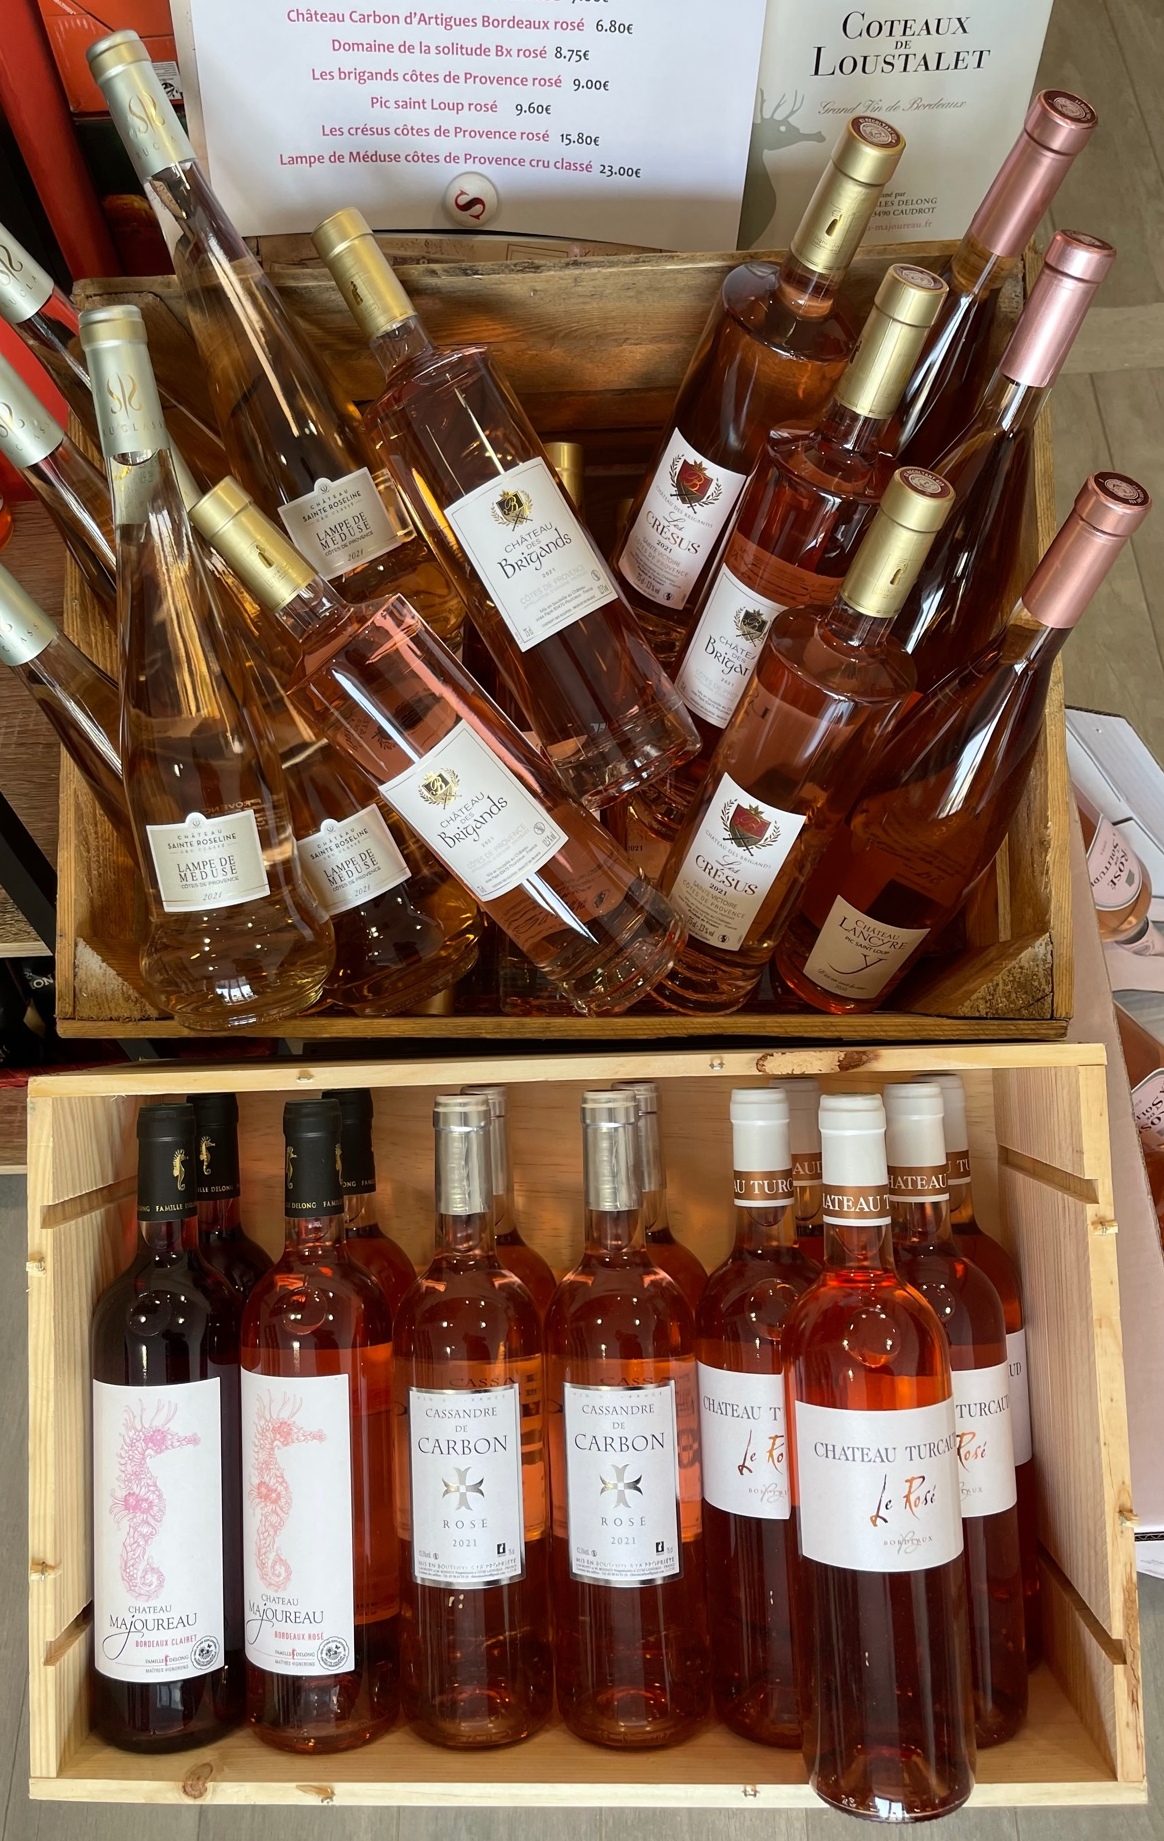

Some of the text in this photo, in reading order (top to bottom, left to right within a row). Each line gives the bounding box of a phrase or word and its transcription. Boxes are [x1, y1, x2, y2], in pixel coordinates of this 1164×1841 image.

[287, 9, 345, 27] Château
[349, 11, 399, 26] Carbon
[482, 15, 549, 32] Bordeaux
[553, 17, 585, 33] rosé
[595, 19, 634, 35] 6.80€
[841, 12, 970, 39] COTEAUX
[331, 39, 590, 63] Domaine de la solitude Bx rosé 8.75€
[895, 40, 912, 50] DE
[810, 46, 991, 77] LOUSTALET
[312, 68, 609, 92] Les brigands côtes de Provence rosé 9.00€
[370, 97, 552, 116] Pic saint Loup rosé 9.60€
[818, 97, 966, 117] Grand Vin de Bordeaux
[322, 123, 600, 147] Les crésus côtes de Provence rosé 15.80€
[280, 149, 641, 179] Lampe de Méduse côtes de Provence cru classé 23.00€
[894, 191, 906, 199] par
[897, 198, 937, 207] DELONG
[893, 207, 936, 216] CAUDROT
[303, 507, 328, 522] SAINTE
[330, 491, 362, 510] ROSELINE
[310, 489, 349, 510] CHÂTEAU
[316, 519, 351, 541] LAMPE
[354, 512, 367, 525] DE
[662, 511, 685, 532] Les
[321, 521, 371, 551] MEDUSE
[504, 522, 553, 553] CHÂTEAU
[646, 510, 700, 555] CRÉSUS
[526, 539, 542, 550] DES
[656, 539, 672, 554] 2021
[648, 552, 689, 578] DE PROVENCE
[656, 550, 681, 568] VICTOIRE
[542, 568, 556, 578] 2021
[553, 564, 586, 587] PROVENCE
[731, 652, 746, 663] DES
[440, 792, 485, 829] CHÂTEAU
[460, 812, 475, 825] DES
[168, 841, 193, 849] SAINTE
[197, 833, 236, 846] ROSELINE
[178, 829, 222, 840] CHÂTEAU
[311, 846, 334, 860] SAINTE
[335, 828, 369, 849] ROSELINE
[318, 828, 355, 848] CHÂTEAU
[481, 836, 495, 848] 2021
[177, 855, 236, 872] LAMPE DE
[323, 857, 358, 878] LAMPE
[359, 848, 375, 862] DE
[327, 857, 379, 886] MEDUSE
[715, 854, 741, 875] Les
[740, 855, 772, 869] BRIGANDS
[179, 865, 237, 882] MEDUSE
[695, 854, 758, 896] CRÉSUS
[682, 879, 746, 919] CÔTES DE PROVENCE
[692, 880, 737, 909] SAINTE VICTOIRE
[709, 883, 728, 896] 2021
[839, 916, 908, 950] LANCYRE
[855, 919, 900, 940] CHÂTEAU
[845, 936, 853, 944] PIC
[855, 942, 872, 952] SAINT
[156, 1203, 183, 1212] FAMILLE
[425, 1406, 497, 1419] CASSANDRE
[582, 1403, 655, 1416] CASSANDRE
[703, 1396, 761, 1421] CHATEAU
[455, 1425, 468, 1433] DE
[612, 1422, 625, 1430] DE
[418, 1435, 508, 1456] CARBON
[574, 1432, 665, 1453] CARBON
[814, 1441, 896, 1463] CHATEAU
[869, 1473, 937, 1527] Le Rosé
[443, 1517, 488, 1529] ROSÉ
[601, 1515, 646, 1527] ROSÉ
[452, 1539, 477, 1547] 2021
[611, 1537, 636, 1545] 2021
[128, 1605, 172, 1614] CHATEAU
[261, 1594, 299, 1606] CHATEAU
[136, 1634, 198, 1648] BORDEAUX CLAIRET
[275, 1631, 324, 1640] BORDEAUX ROSÉ
[169, 1655, 189, 1663] DELONG
